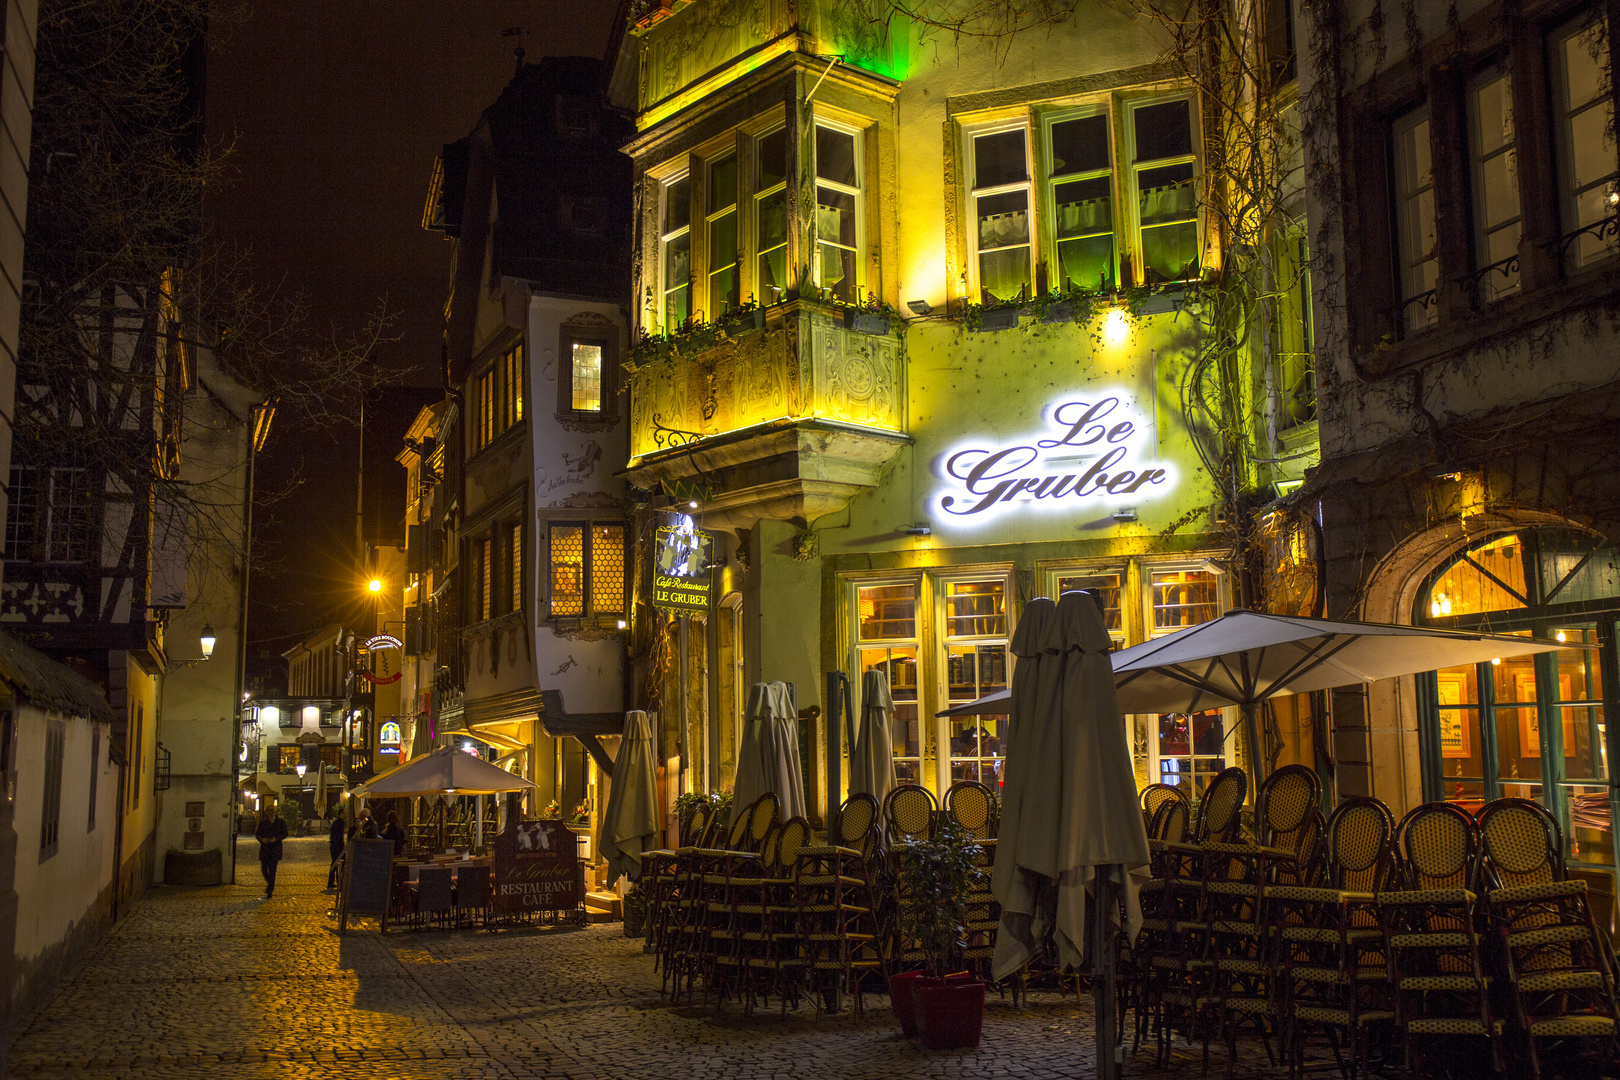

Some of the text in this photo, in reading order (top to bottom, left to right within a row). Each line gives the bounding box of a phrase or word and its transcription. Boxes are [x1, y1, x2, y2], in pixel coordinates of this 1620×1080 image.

[1037, 396, 1136, 449] Le
[940, 446, 1167, 516] Gruber
[657, 591, 708, 605] LE GRUBER
[526, 862, 570, 880] Gruber
[500, 880, 574, 896] RESTAURANT
